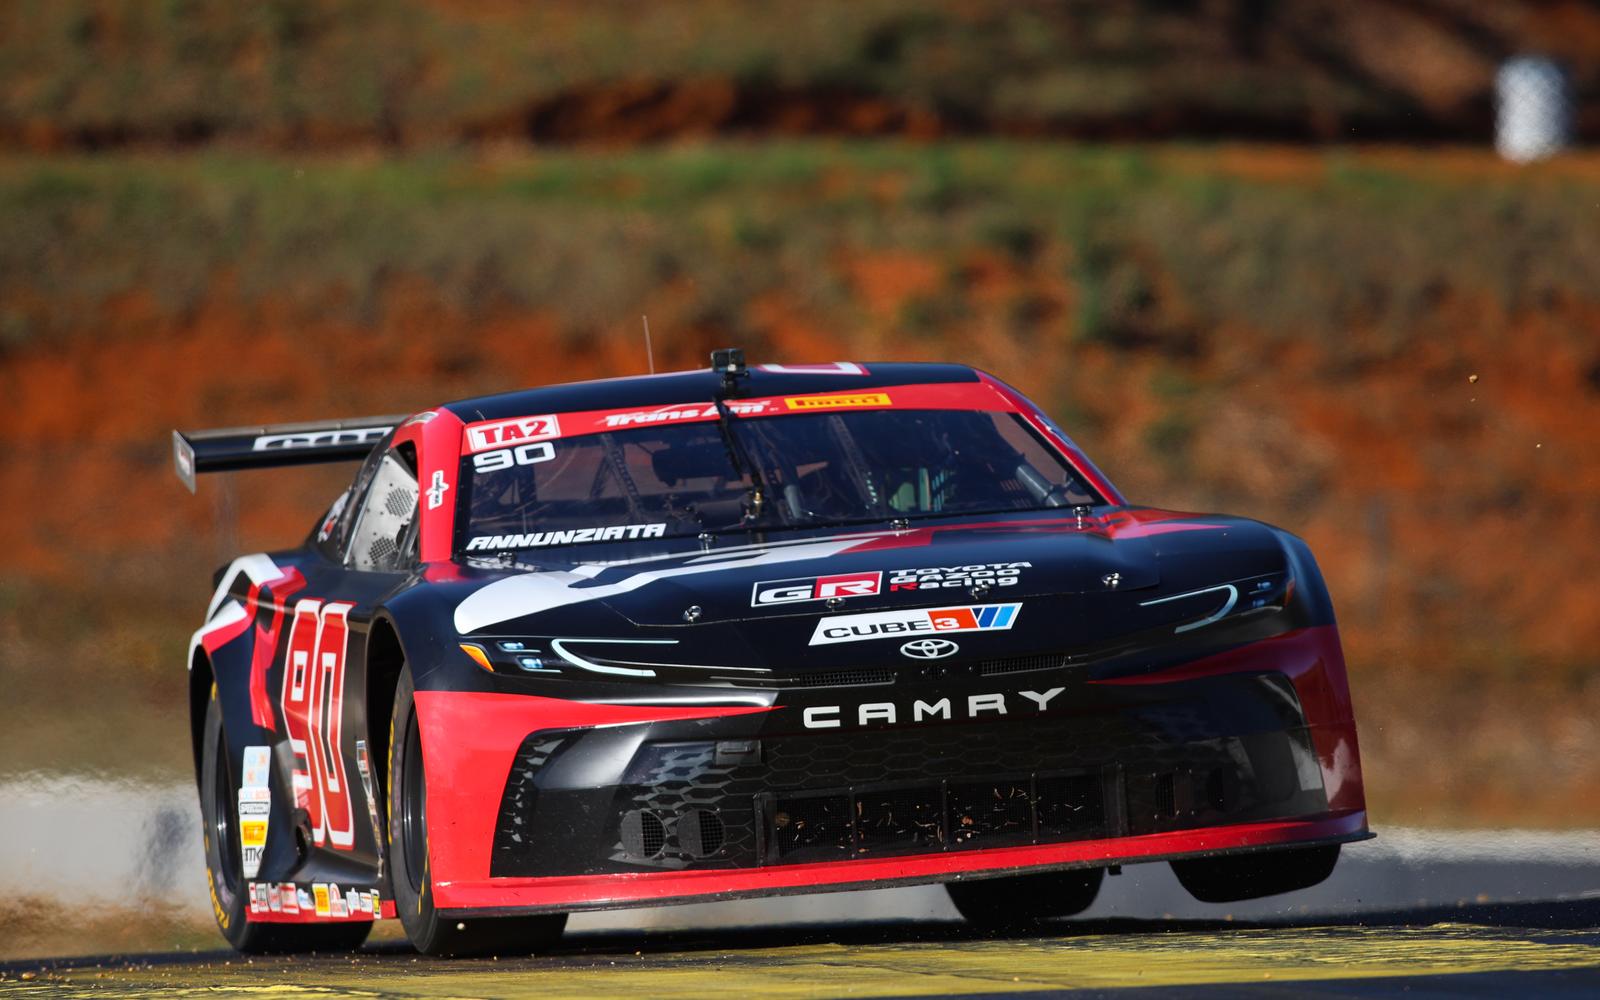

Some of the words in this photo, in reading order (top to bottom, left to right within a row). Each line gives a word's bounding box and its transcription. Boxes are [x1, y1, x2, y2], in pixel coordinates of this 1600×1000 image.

[605, 409, 700, 427] Trans
[477, 419, 549, 447] TA2
[473, 441, 556, 474] 90
[466, 523, 666, 551] ANNUNZIATA
[889, 561, 1032, 577] TOYOTA
[890, 569, 1021, 584] GAZOO
[758, 579, 875, 603] GR
[890, 576, 1019, 591] Racing
[803, 687, 1066, 729] CAMRY
[281, 599, 354, 848] 90
